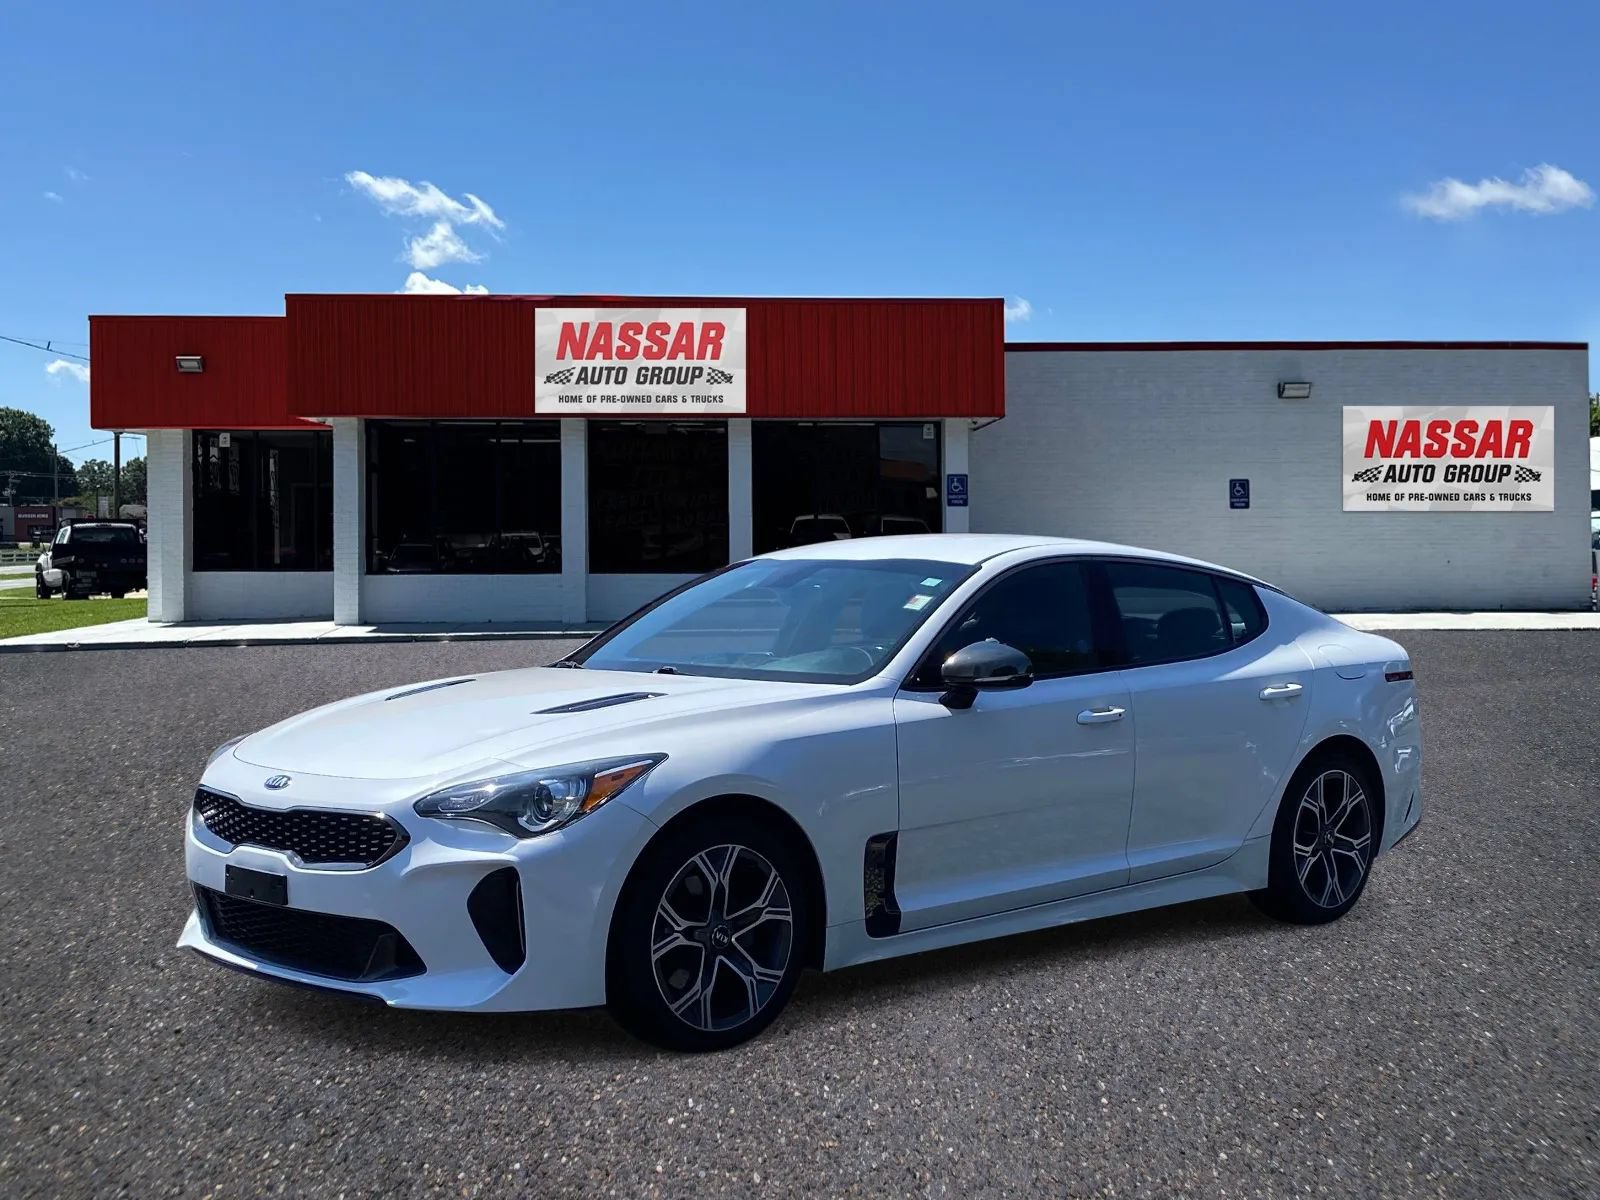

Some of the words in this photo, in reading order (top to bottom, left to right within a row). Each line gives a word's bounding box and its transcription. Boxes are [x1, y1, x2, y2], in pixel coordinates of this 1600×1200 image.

[555, 322, 726, 361] NASSAR
[575, 366, 628, 385] AUTO
[635, 366, 704, 385] GROUP
[558, 395, 583, 404] HOME
[586, 395, 597, 404] OF
[600, 395, 652, 404] PRE-OWNED
[655, 395, 678, 404] CARS
[681, 395, 687, 404] &
[690, 395, 724, 404] TRUCKS
[1363, 420, 1534, 459] NASSAR
[1383, 464, 1436, 483] AUTO
[1443, 464, 1512, 483] GROUP
[1366, 493, 1391, 502] HOME
[1394, 493, 1405, 502] OF
[1408, 493, 1460, 502] PRE-OWNED
[1463, 493, 1486, 502] CARS
[1489, 493, 1495, 502] &
[1498, 493, 1532, 502] TRUCKS
[265, 776, 288, 787] KIA
